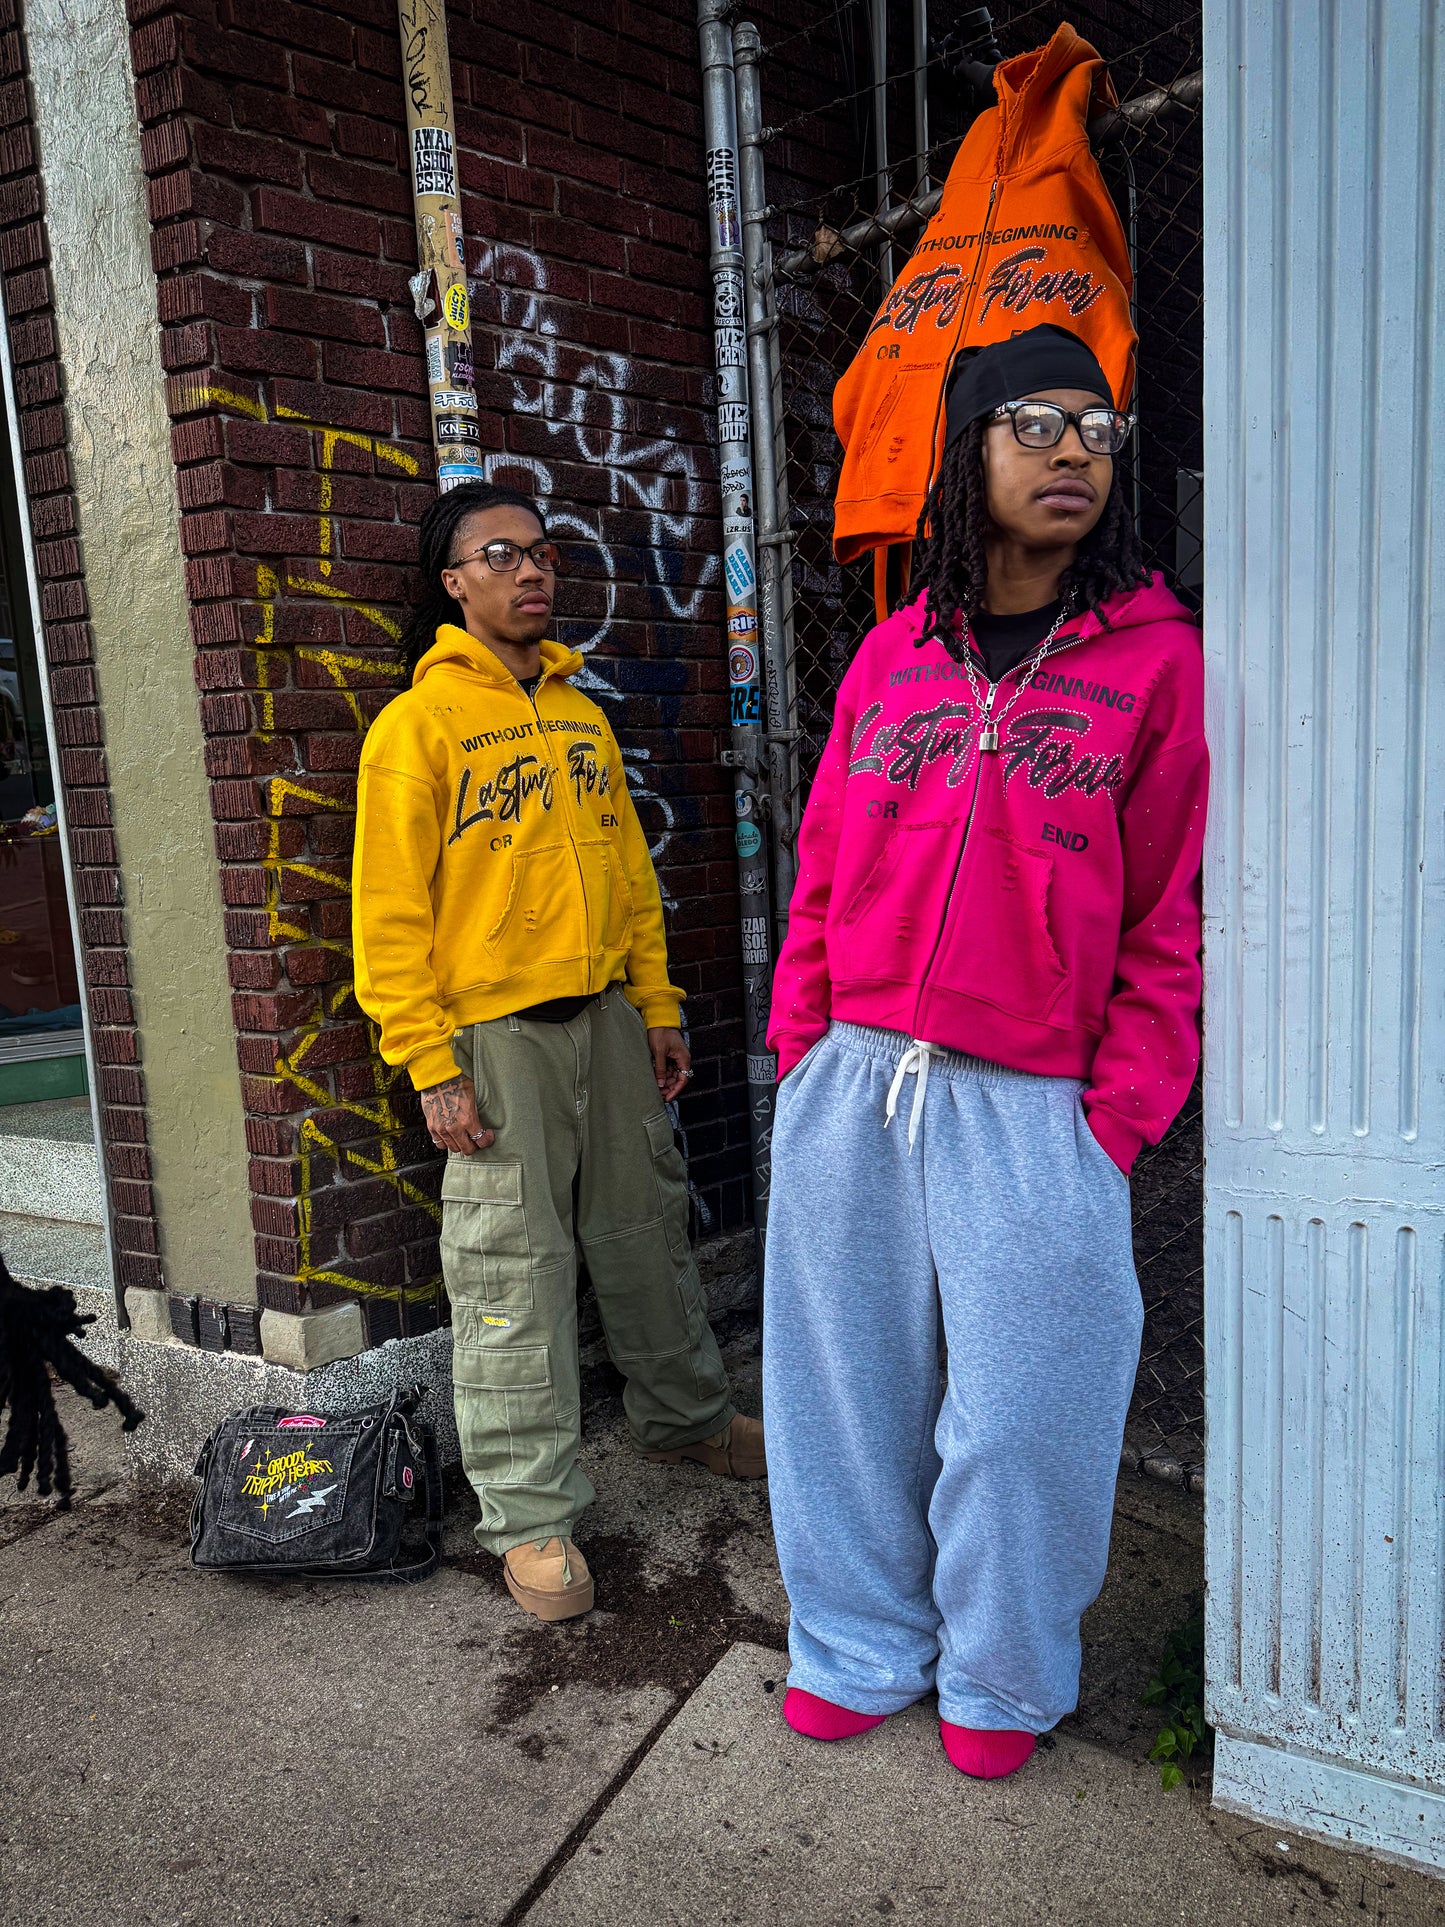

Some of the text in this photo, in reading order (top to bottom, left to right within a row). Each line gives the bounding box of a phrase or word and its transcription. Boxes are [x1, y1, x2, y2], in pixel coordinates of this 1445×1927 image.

[415, 128, 453, 154] AWAL
[415, 150, 454, 175] ASHOL
[416, 171, 455, 196] ESEK
[977, 223, 1079, 246] BEGINNING
[980, 246, 1106, 326] Forever
[877, 343, 901, 360] OR
[889, 662, 972, 688] WITHOU
[460, 719, 603, 753] WITHOUT BEGINNING
[448, 753, 559, 846] Lasting
[866, 799, 1089, 853] OR END
[489, 833, 513, 852] OR
[241, 1459, 334, 1496] TRIPPY HEART
